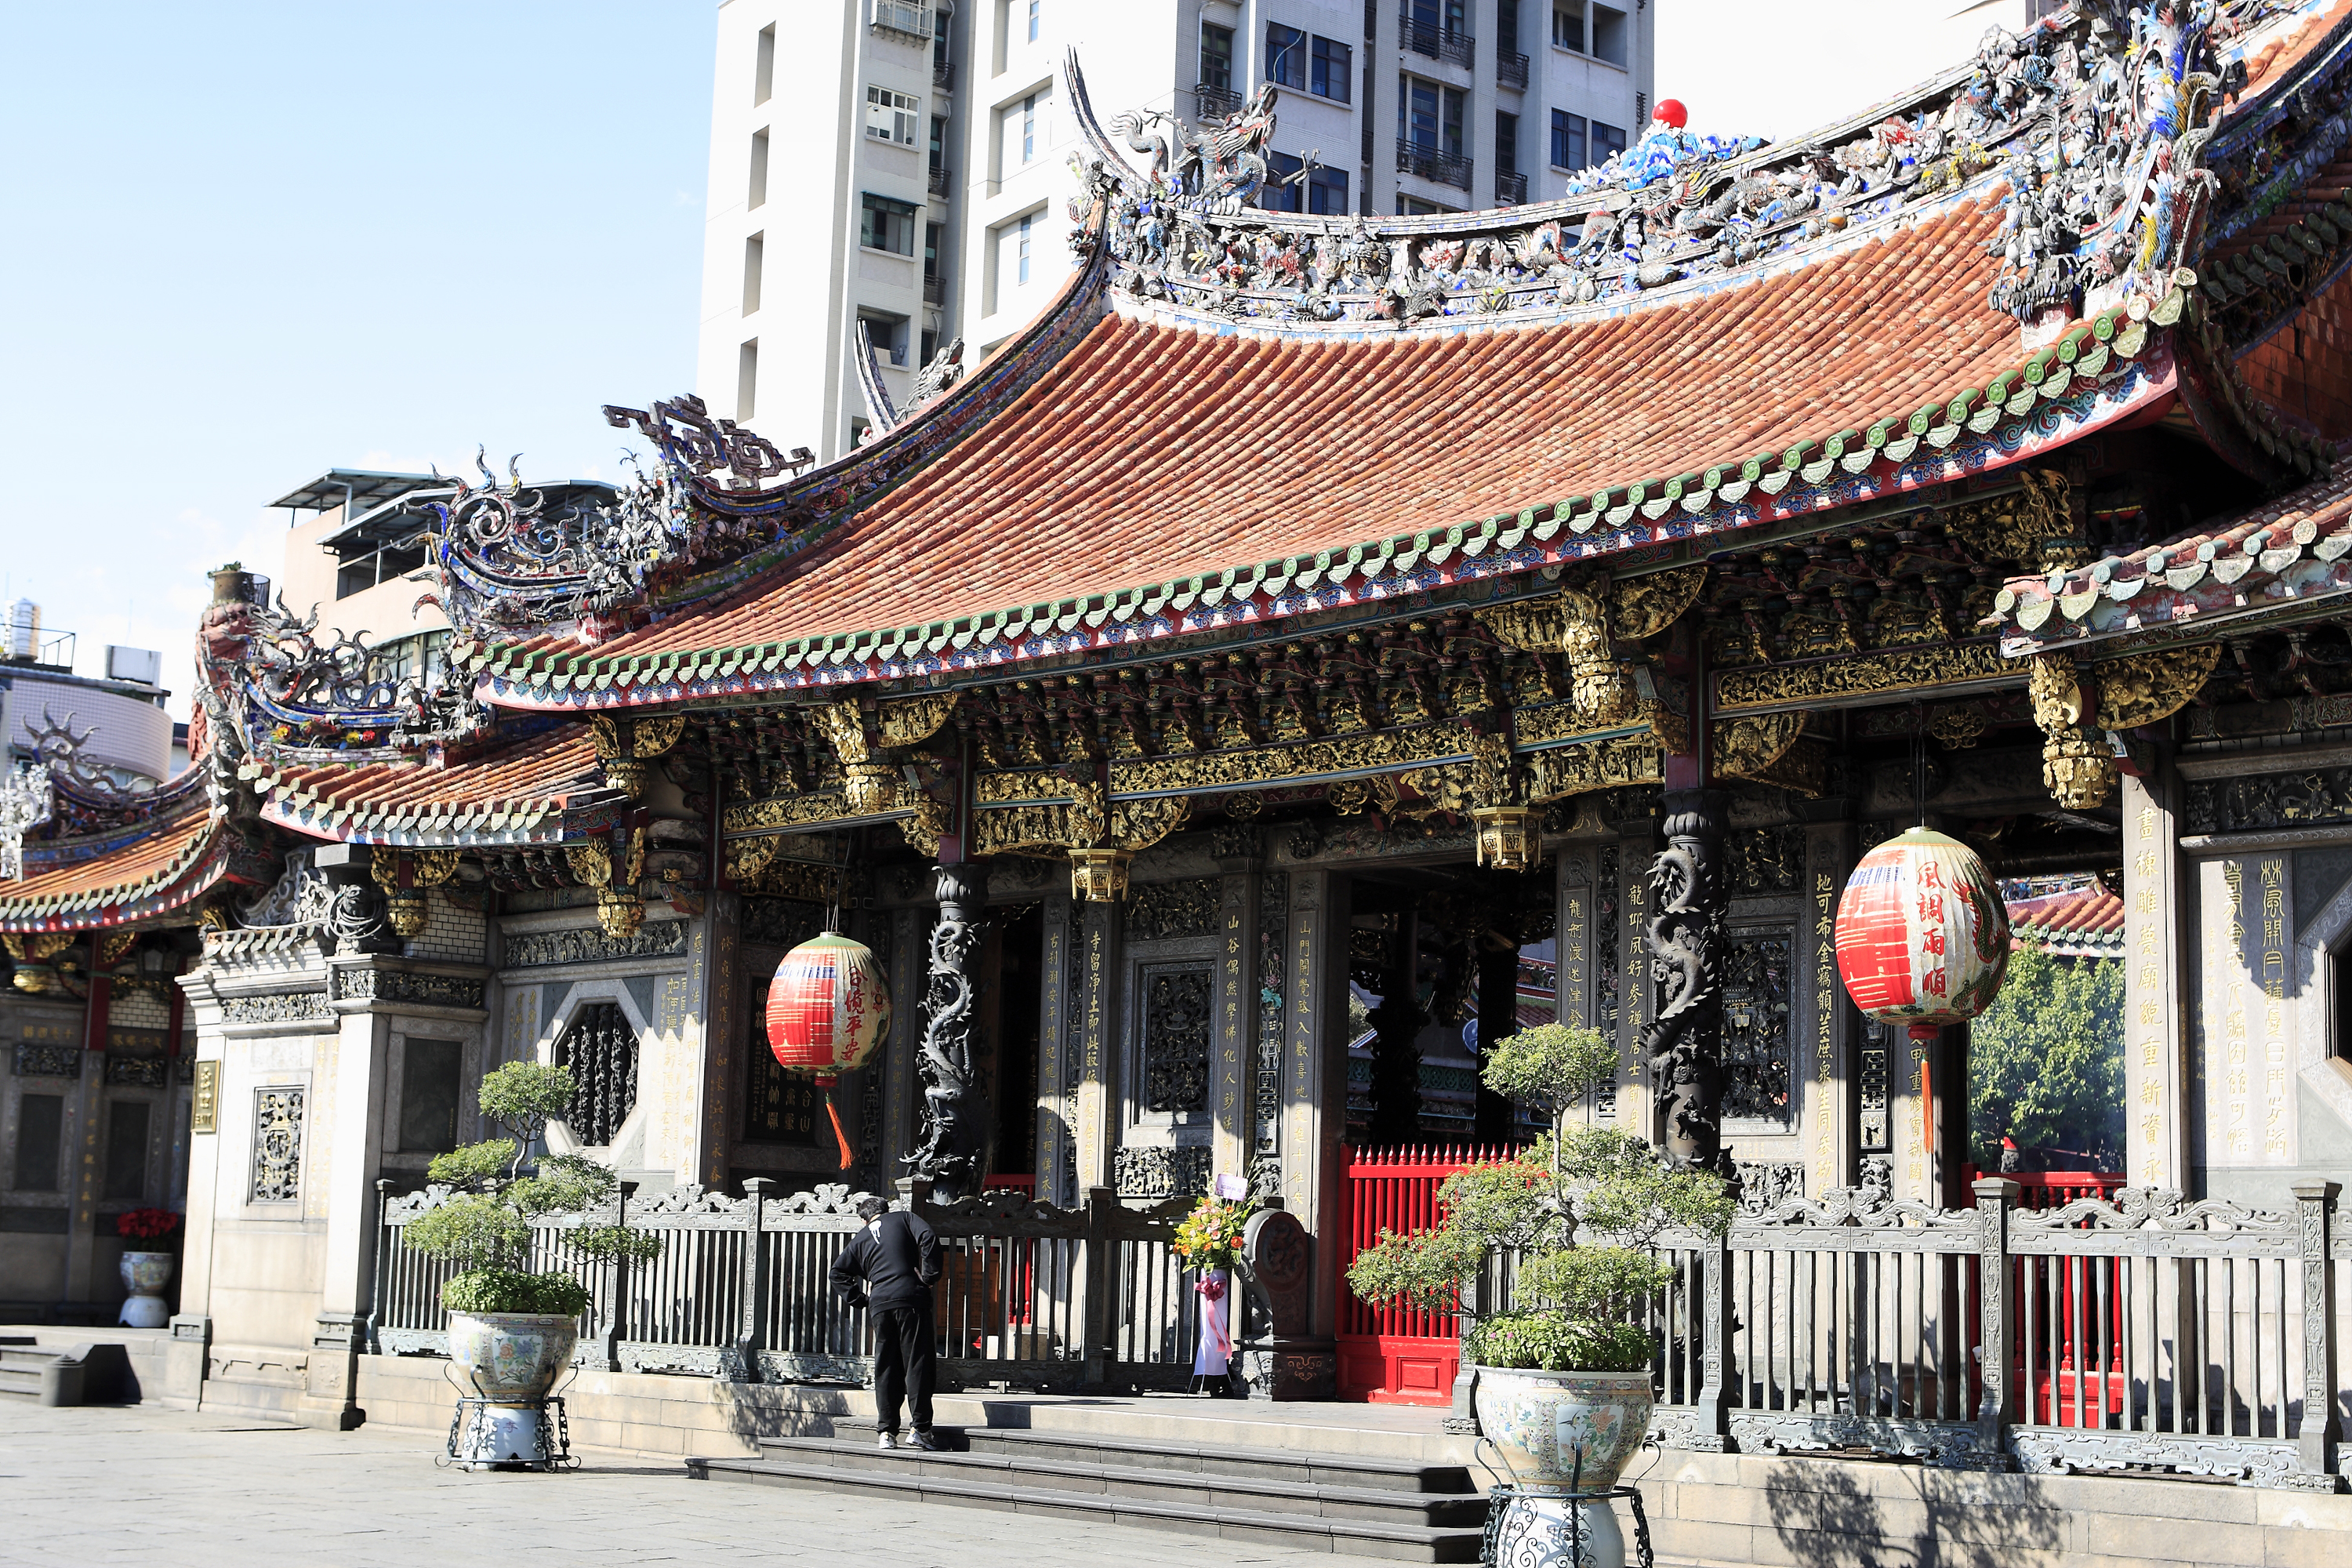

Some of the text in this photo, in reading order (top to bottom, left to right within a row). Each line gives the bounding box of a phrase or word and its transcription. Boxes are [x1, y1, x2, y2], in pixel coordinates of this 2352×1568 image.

[1916, 861, 1947, 998] 風調雨順
[840, 966, 868, 1062] 合境平安
